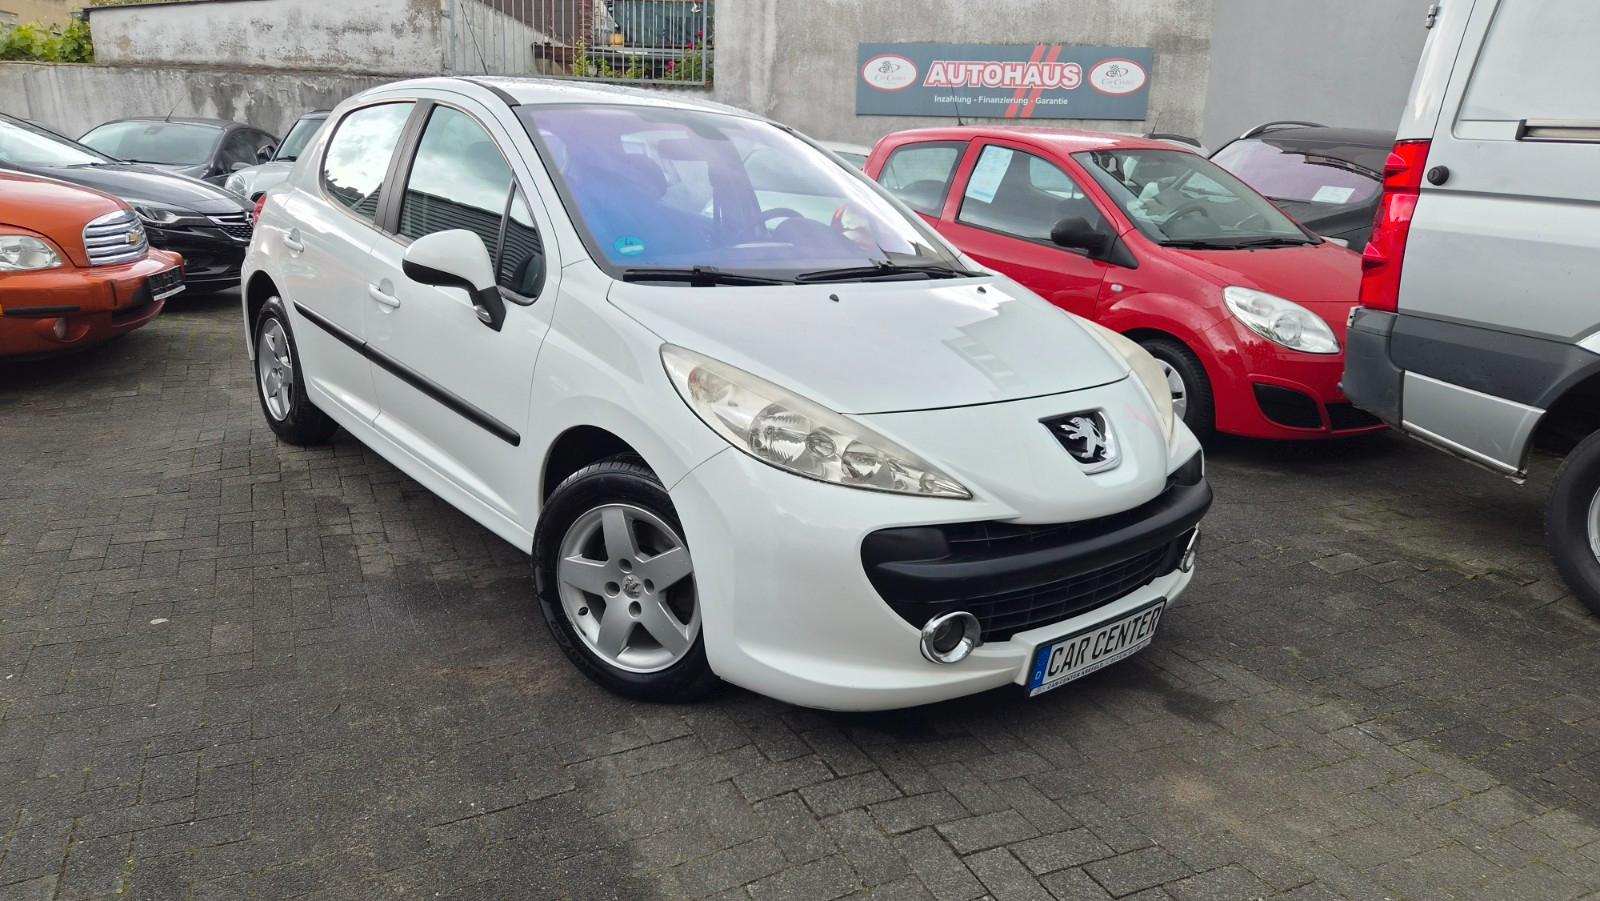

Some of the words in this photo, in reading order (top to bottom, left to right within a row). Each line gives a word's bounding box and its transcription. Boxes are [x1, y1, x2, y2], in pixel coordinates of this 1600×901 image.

[924, 61, 1082, 89] AUTOHAUS
[934, 95, 972, 104] Inzahlung
[978, 96, 1029, 106] Finanzierung
[1035, 97, 1068, 105] Garantie
[1048, 636, 1091, 676] CAR
[1091, 606, 1162, 660] CENTER
